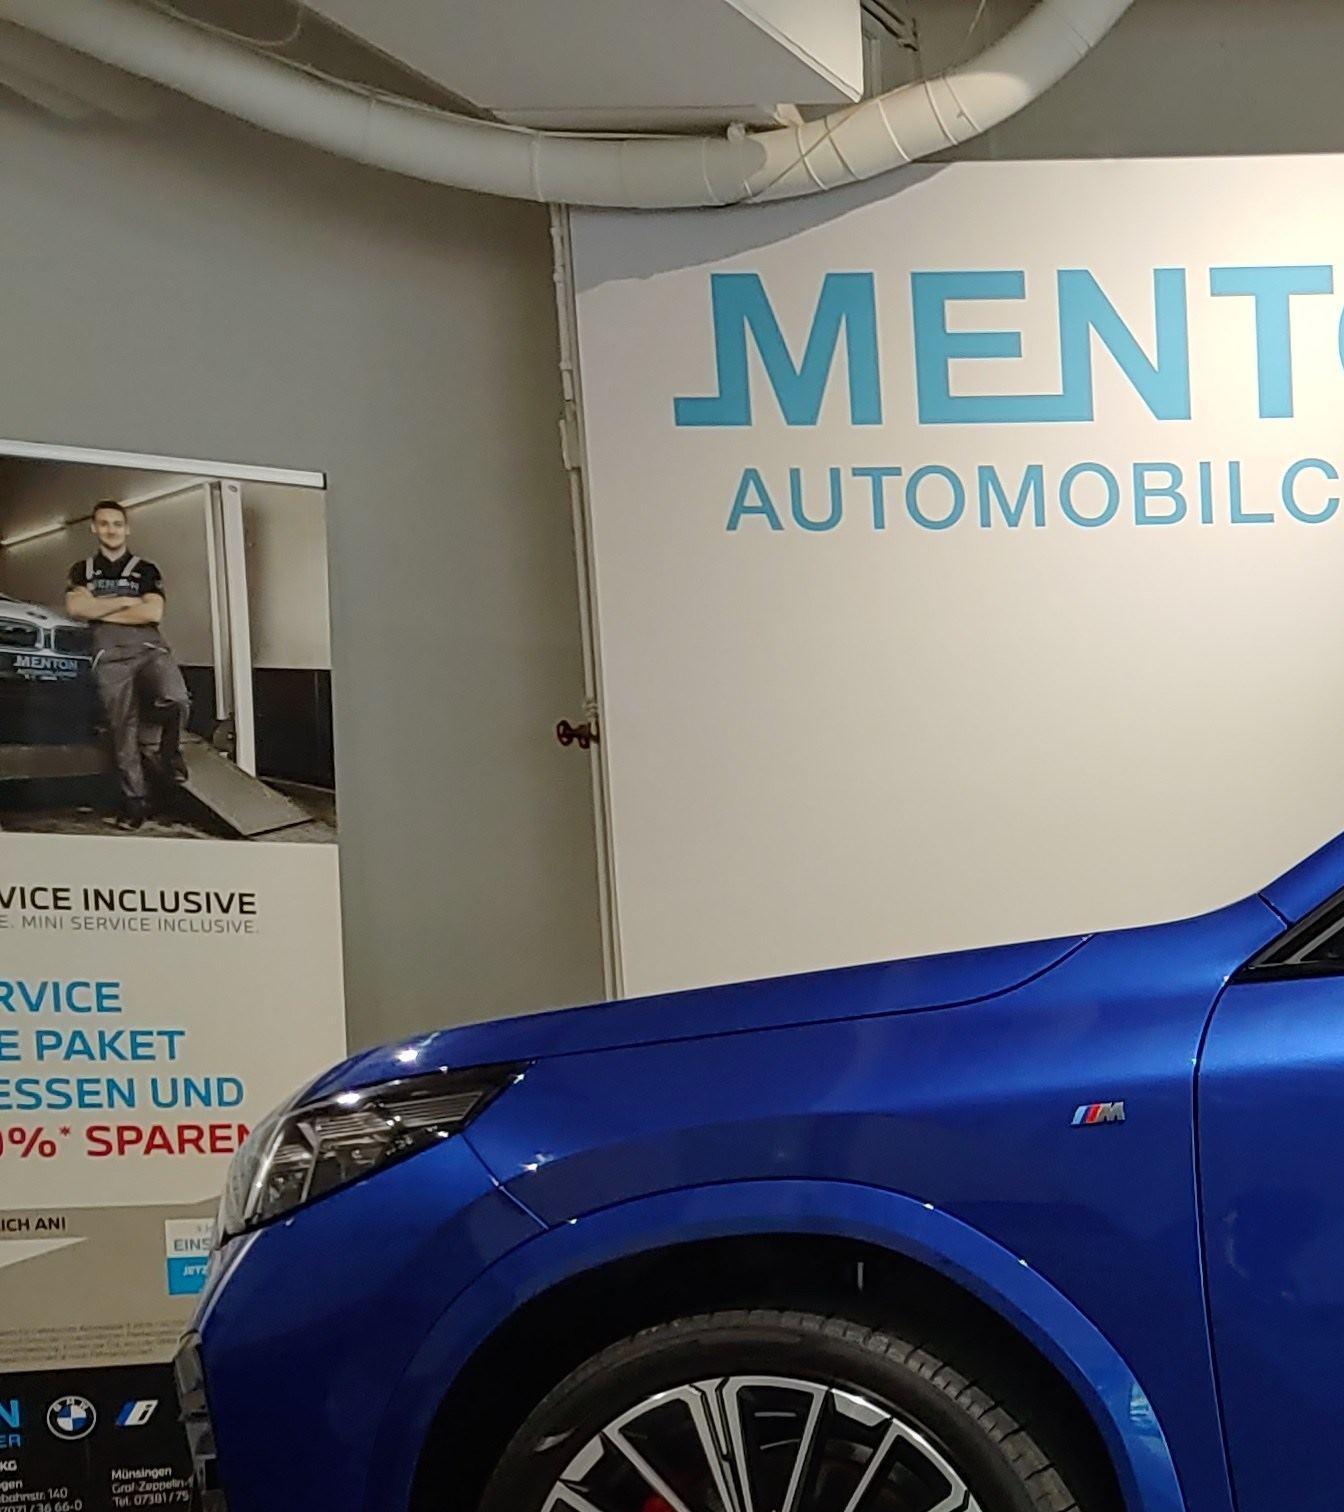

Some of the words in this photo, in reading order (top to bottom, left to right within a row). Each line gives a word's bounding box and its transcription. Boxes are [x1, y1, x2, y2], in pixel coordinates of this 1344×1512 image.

[13, 654, 78, 671] MENTON
[0, 886, 72, 911] VICE
[83, 887, 258, 915] INCLUSIVE
[22, 915, 64, 931] MINI
[70, 915, 151, 933] SERVICE
[0, 981, 122, 1013] RVICE
[35, 1030, 186, 1061] PAKET
[0, 1077, 136, 1110] ESSEN
[150, 1076, 244, 1109] UND
